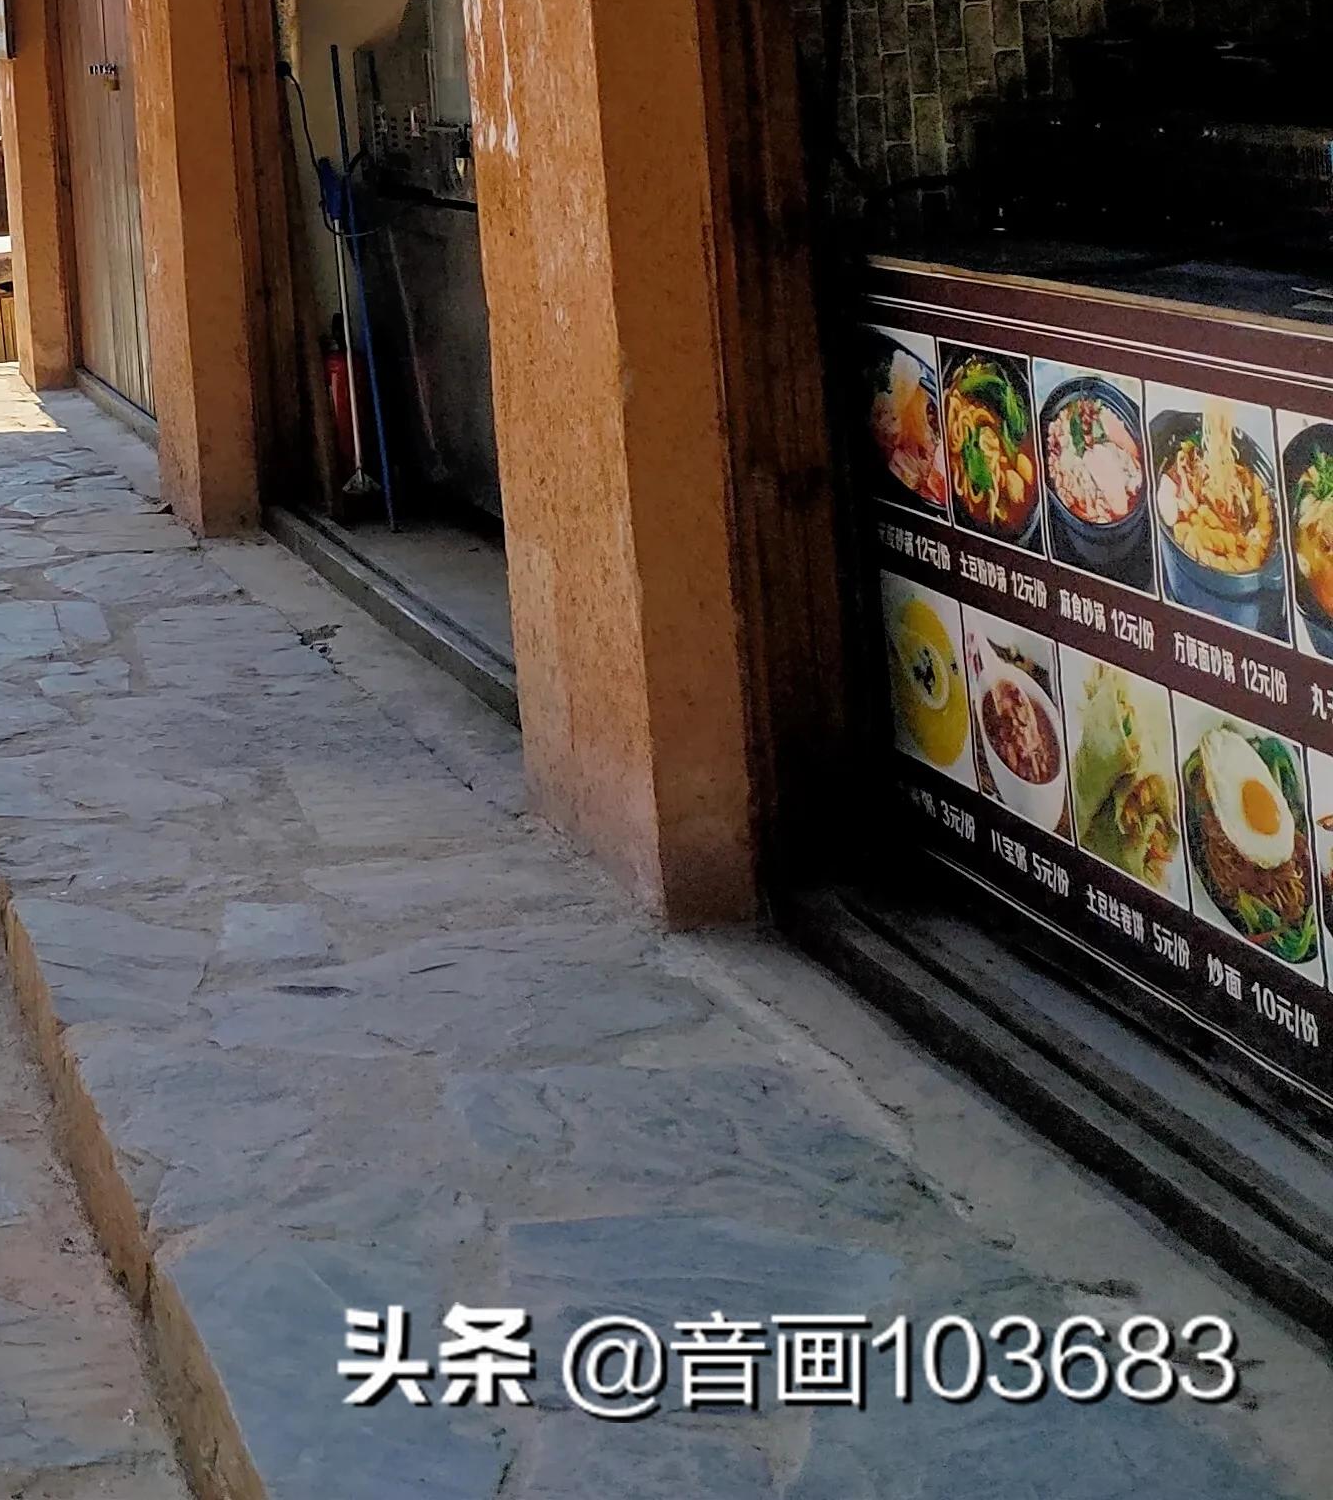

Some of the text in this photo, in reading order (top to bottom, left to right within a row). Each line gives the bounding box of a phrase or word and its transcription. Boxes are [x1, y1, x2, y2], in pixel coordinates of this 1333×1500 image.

[1010, 570, 1047, 609] 12元/份
[1059, 588, 1155, 651] 麻食砂锅 12元/份
[1173, 631, 1288, 704] 方便面砂锅 12元/份
[940, 799, 976, 843] 3元/份
[990, 828, 1070, 897] 八宝粥 5元/份
[1084, 883, 1191, 970] 土豆丝卷饼 5元/份
[1206, 953, 1320, 1048] 炒面 10元/份
